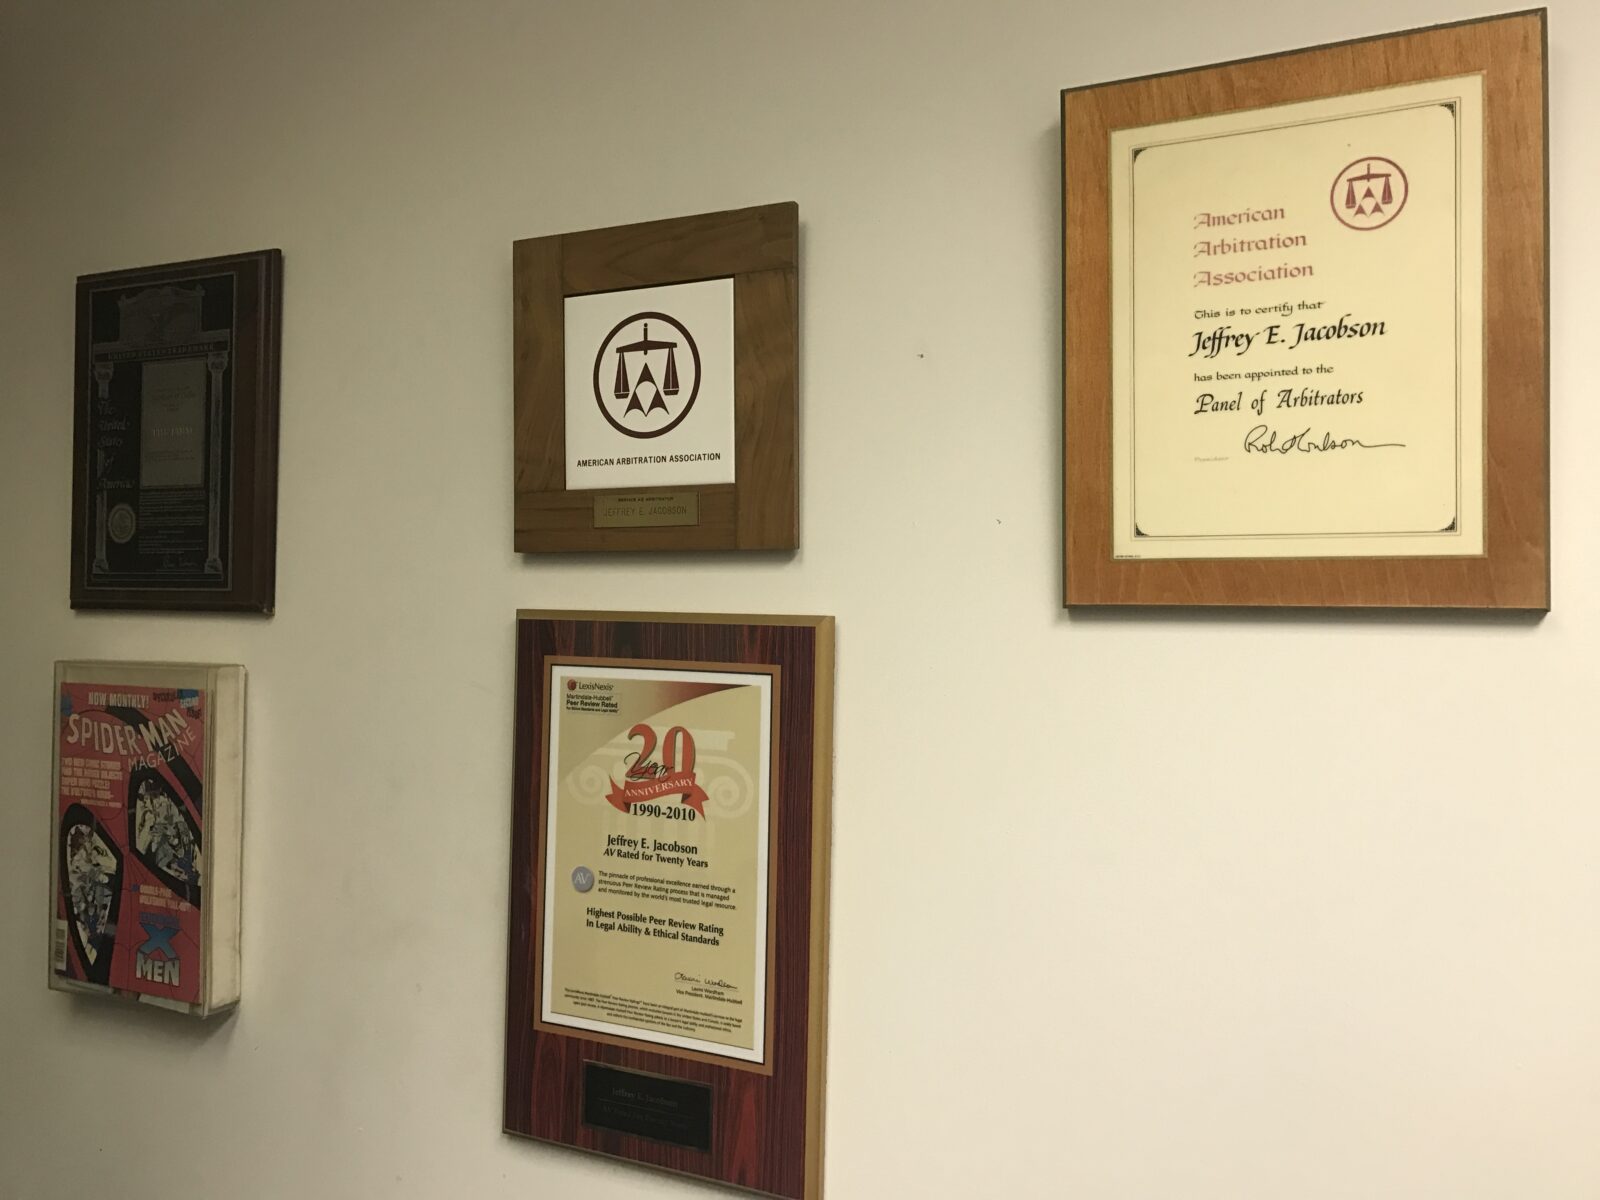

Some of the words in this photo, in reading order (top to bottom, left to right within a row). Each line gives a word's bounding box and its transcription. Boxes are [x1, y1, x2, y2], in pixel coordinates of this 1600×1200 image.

[1194, 206, 1285, 229] American
[1194, 232, 1307, 258] Arbitration
[1194, 262, 1314, 287] Association
[1194, 309, 1220, 319] This
[1225, 307, 1235, 317] is
[1240, 304, 1252, 315] to
[1255, 301, 1293, 317] certify
[1297, 300, 1326, 311] that
[1188, 326, 1260, 358] Jeffrey
[1263, 324, 1286, 345] E.
[1288, 313, 1386, 350] Jacobson
[1194, 372, 1213, 382] has
[1216, 370, 1241, 381] been
[1245, 366, 1298, 382] appointed
[1302, 365, 1313, 374] to
[1316, 364, 1334, 374] the
[1194, 392, 1243, 415] Panel
[1251, 389, 1268, 416] of
[1276, 387, 1364, 409] Arbitrators
[577, 457, 614, 467] AMERICAN
[616, 455, 667, 466] ARBITRATION
[669, 452, 721, 463] ASSOCIATION
[648, 505, 687, 516] JACOBSON
[88, 692, 107, 706] NOW
[109, 692, 149, 708] MONTHLY!
[580, 700, 600, 708] Review
[128, 727, 196, 772] MAGAZINE
[625, 723, 696, 779] 20
[624, 752, 675, 783] Year
[624, 777, 694, 798] ANNIVERSARY
[632, 803, 696, 822] 1990-2010
[607, 834, 638, 849] Jeffrey
[641, 838, 650, 850] E.
[653, 840, 698, 855] Jacobson
[603, 848, 617, 857] AV
[617, 849, 640, 860] Rated
[641, 850, 653, 861] for
[656, 853, 685, 867] Twenty
[687, 856, 708, 868] Years
[574, 872, 590, 885] AV
[636, 874, 665, 885] professional
[665, 879, 691, 888] excellence
[692, 882, 710, 890] earned
[710, 884, 732, 894] through
[633, 889, 640, 898] by
[650, 892, 668, 901] world's
[669, 895, 681, 903] most
[682, 897, 700, 905] trusted
[701, 899, 713, 908] legal
[634, 883, 651, 891] Review
[669, 888, 688, 896] process
[689, 889, 700, 897] that
[706, 892, 730, 901] managed
[587, 907, 615, 920] Highest
[616, 910, 647, 923] Possible
[649, 915, 666, 926] Peer
[668, 918, 697, 931] Review
[698, 922, 724, 936] Rating
[139, 923, 182, 960] X
[586, 919, 594, 928] In
[596, 921, 616, 932] Legal
[617, 923, 642, 936] Ability
[644, 927, 651, 936] &
[653, 928, 679, 940] Ethical
[681, 932, 719, 946] Standards
[135, 951, 181, 987] MEN
